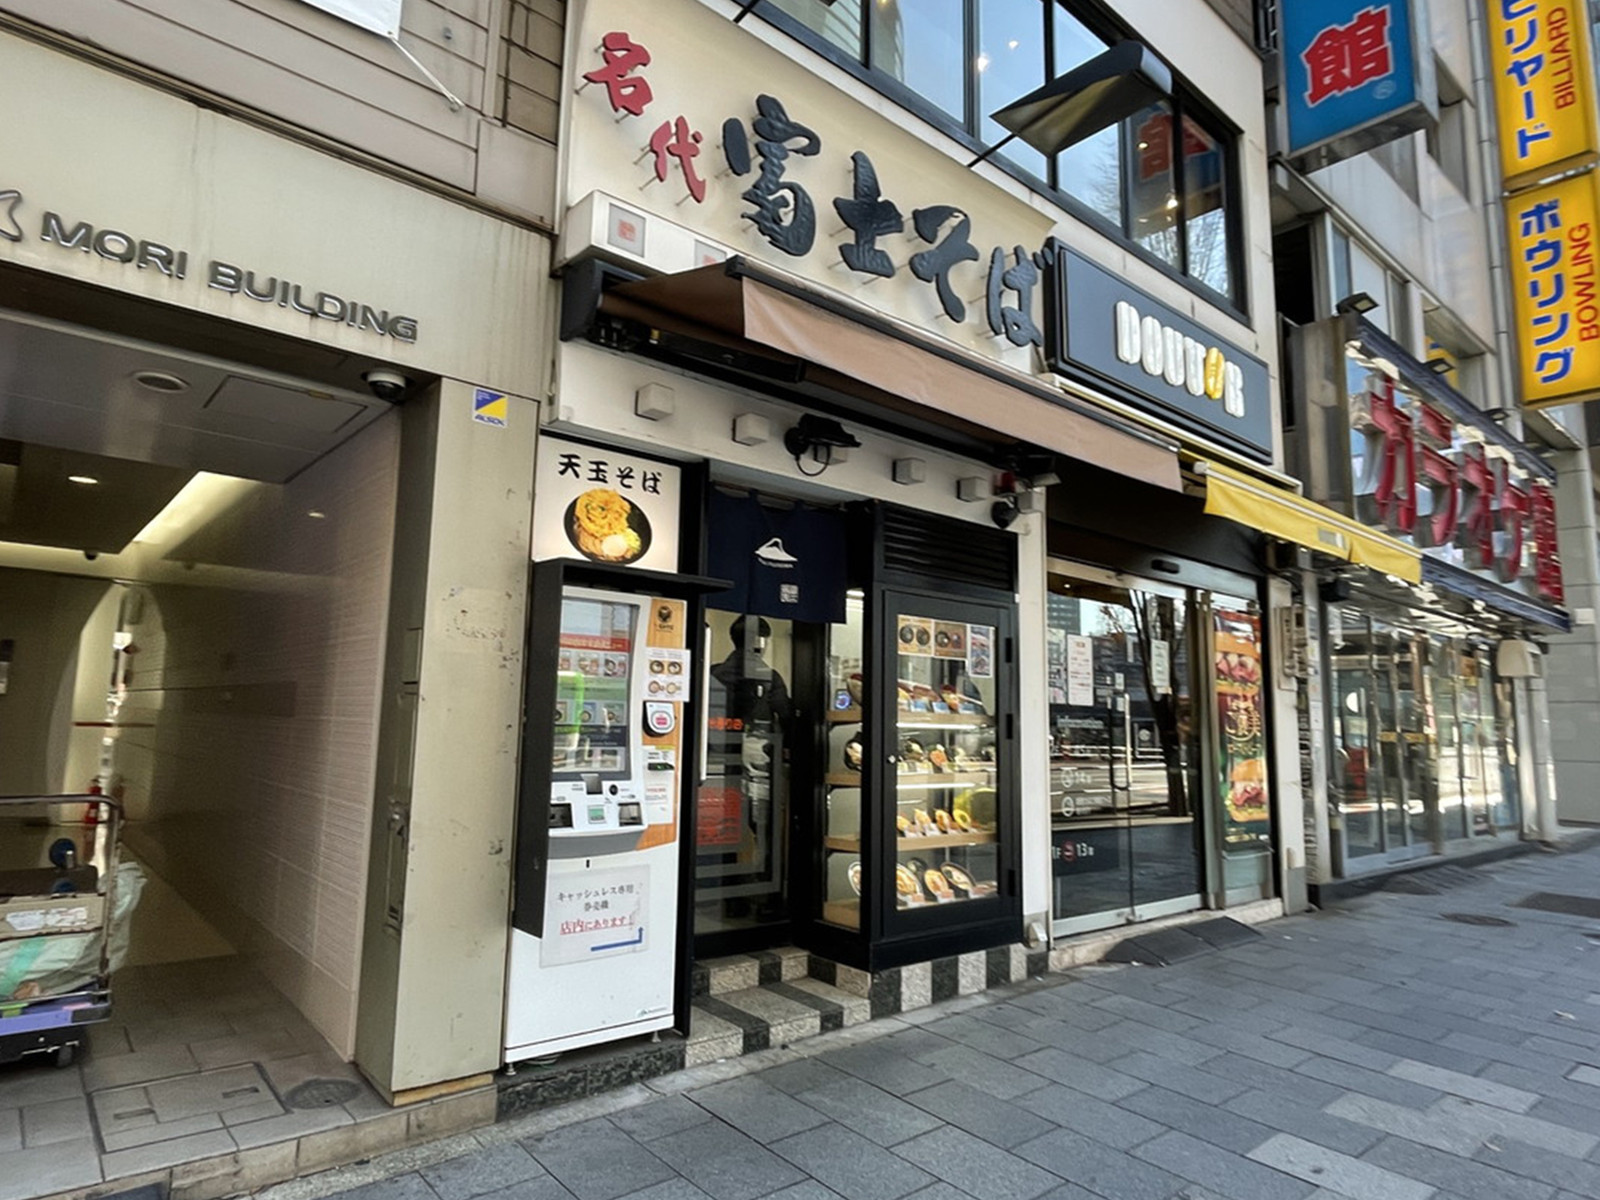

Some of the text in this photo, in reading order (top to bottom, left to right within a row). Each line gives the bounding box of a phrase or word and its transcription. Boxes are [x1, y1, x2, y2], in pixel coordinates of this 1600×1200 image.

[1301, 5, 1392, 108] 館
[1546, 6, 1578, 110] BILLIARD
[583, 31, 1053, 347] 名代 富士そば
[40, 211, 418, 344] MORI BUILDING
[1519, 198, 1575, 384] ボウリング
[1567, 222, 1600, 342] BOWLING
[1115, 300, 1246, 418] DOUTOR
[558, 453, 662, 495] 天玉そば
